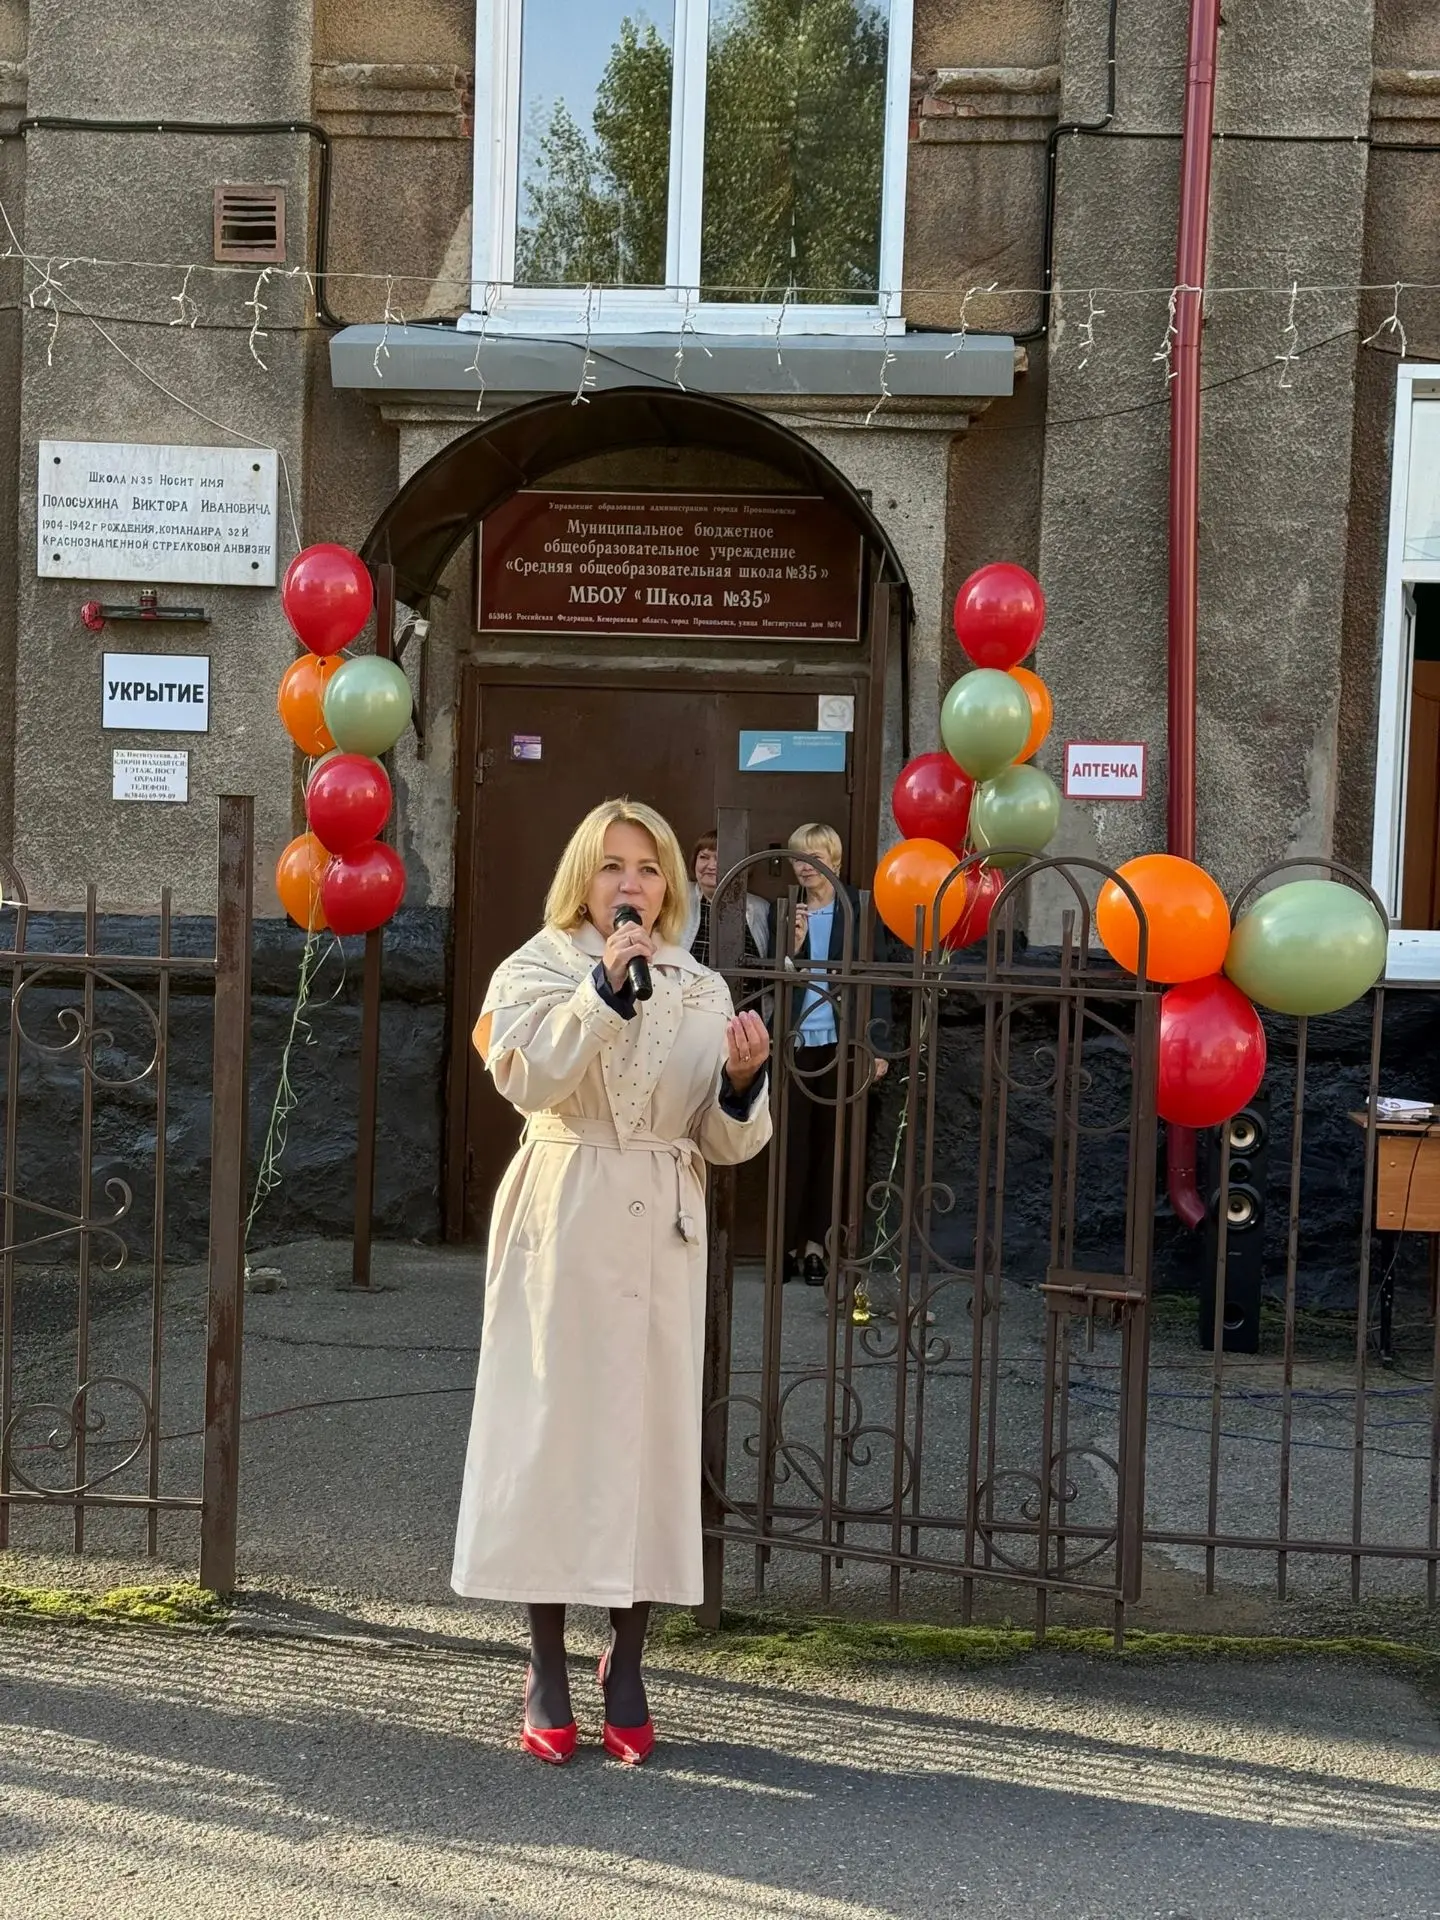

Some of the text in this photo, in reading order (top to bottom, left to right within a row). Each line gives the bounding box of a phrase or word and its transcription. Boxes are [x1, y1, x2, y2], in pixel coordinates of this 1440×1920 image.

[567, 519, 774, 539] Муниципальное бюджетное
[544, 538, 796, 561] общеобразовательное учреждение
[506, 557, 573, 577] «Средняя
[579, 560, 732, 579] общеобразовательная
[738, 568, 783, 579] школа
[568, 585, 627, 604] МБОУ
[516, 613, 554, 622] Российская
[108, 681, 204, 703] УКРЫТИЕ
[1072, 763, 1138, 778] АПТЕЧКА
